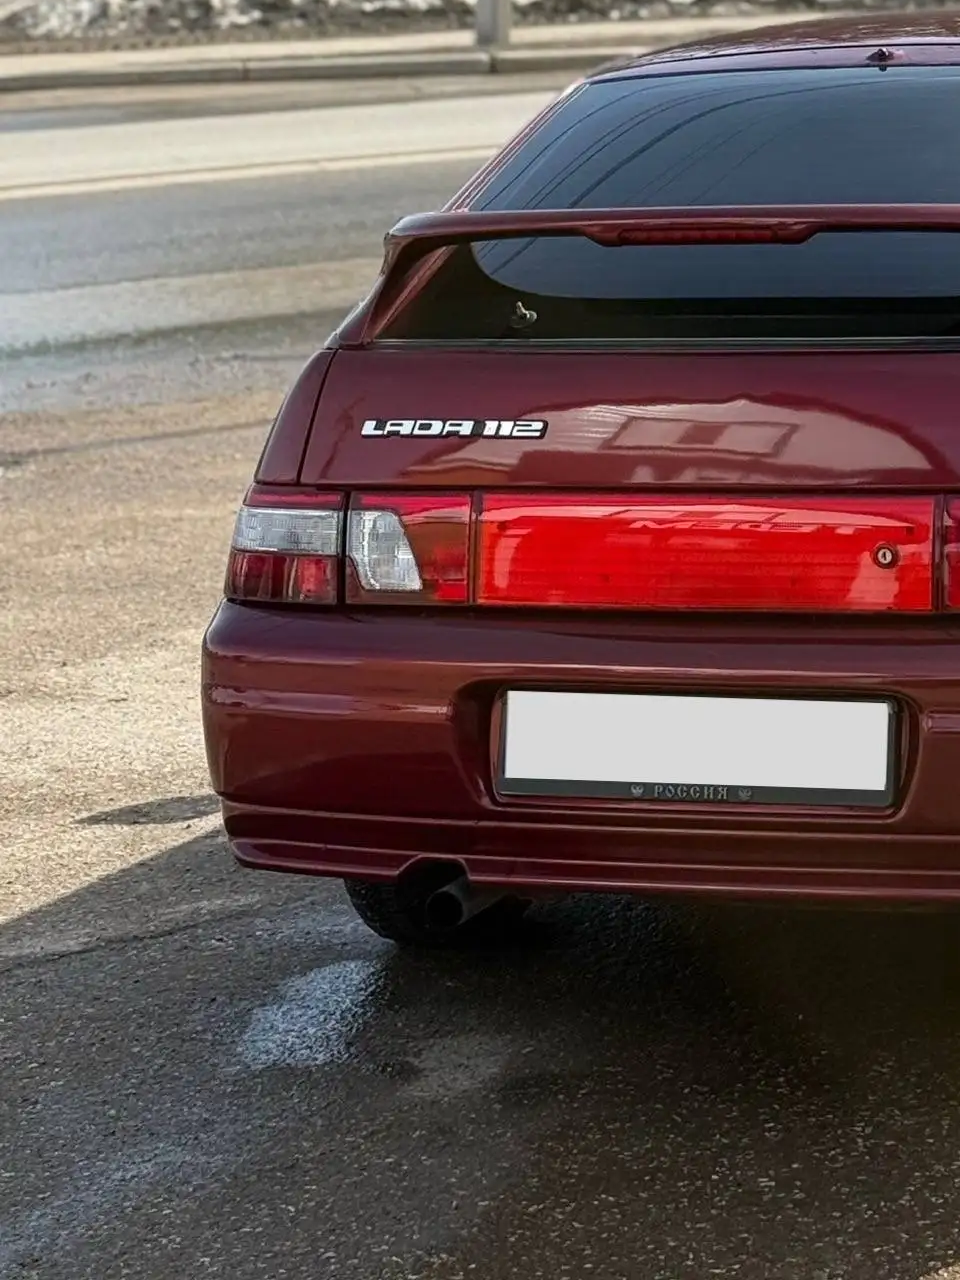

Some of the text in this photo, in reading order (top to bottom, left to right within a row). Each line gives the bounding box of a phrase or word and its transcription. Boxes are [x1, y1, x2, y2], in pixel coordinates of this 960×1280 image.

[360, 420, 546, 437] LADA 112
[653, 784, 729, 800] РОССИЯ
